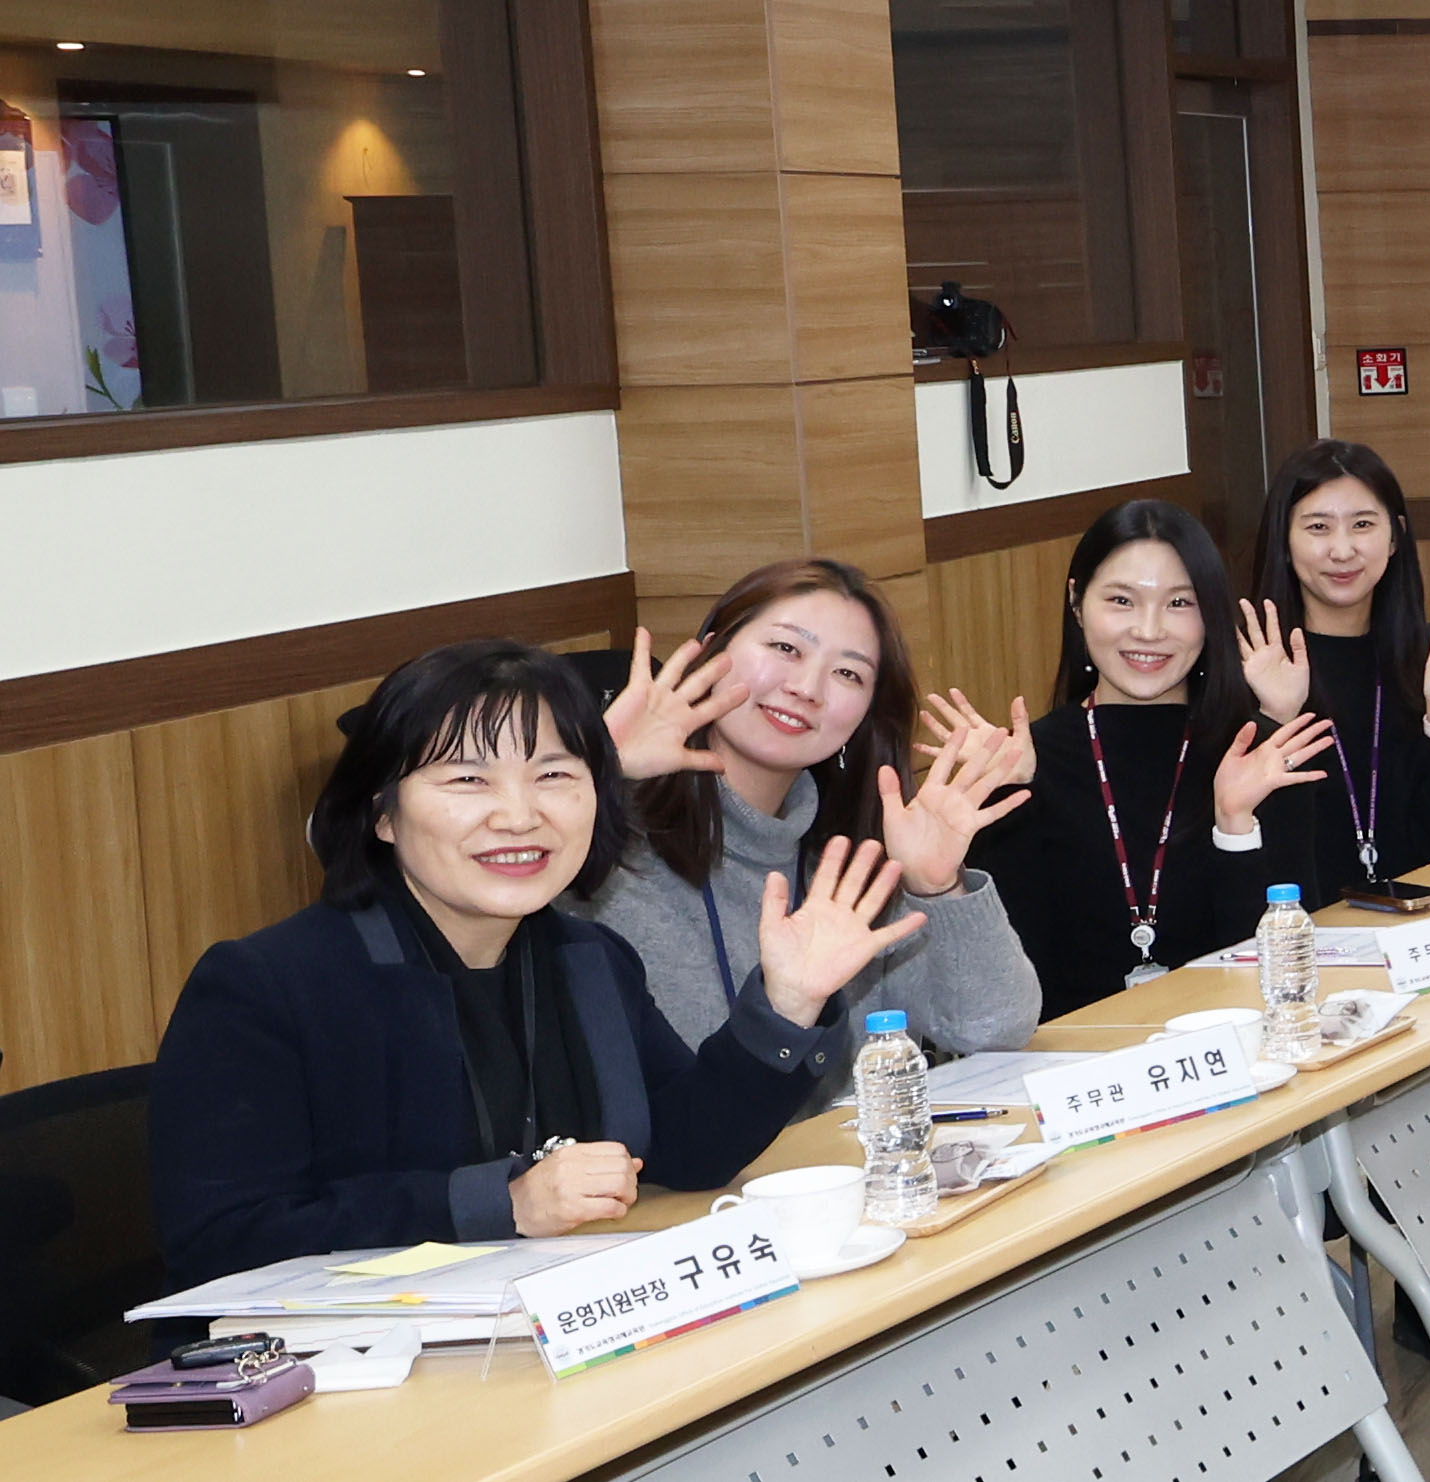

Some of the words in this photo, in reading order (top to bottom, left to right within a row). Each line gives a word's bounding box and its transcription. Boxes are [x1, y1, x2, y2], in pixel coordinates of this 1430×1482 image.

[1361, 352, 1402, 365] 소화기
[1009, 411, 1021, 445] Canon
[1066, 1082, 1126, 1114] 주무관
[1147, 1048, 1229, 1093] 유지연
[556, 1277, 671, 1336] 운영지원부장
[673, 1233, 779, 1291] 구유숙
